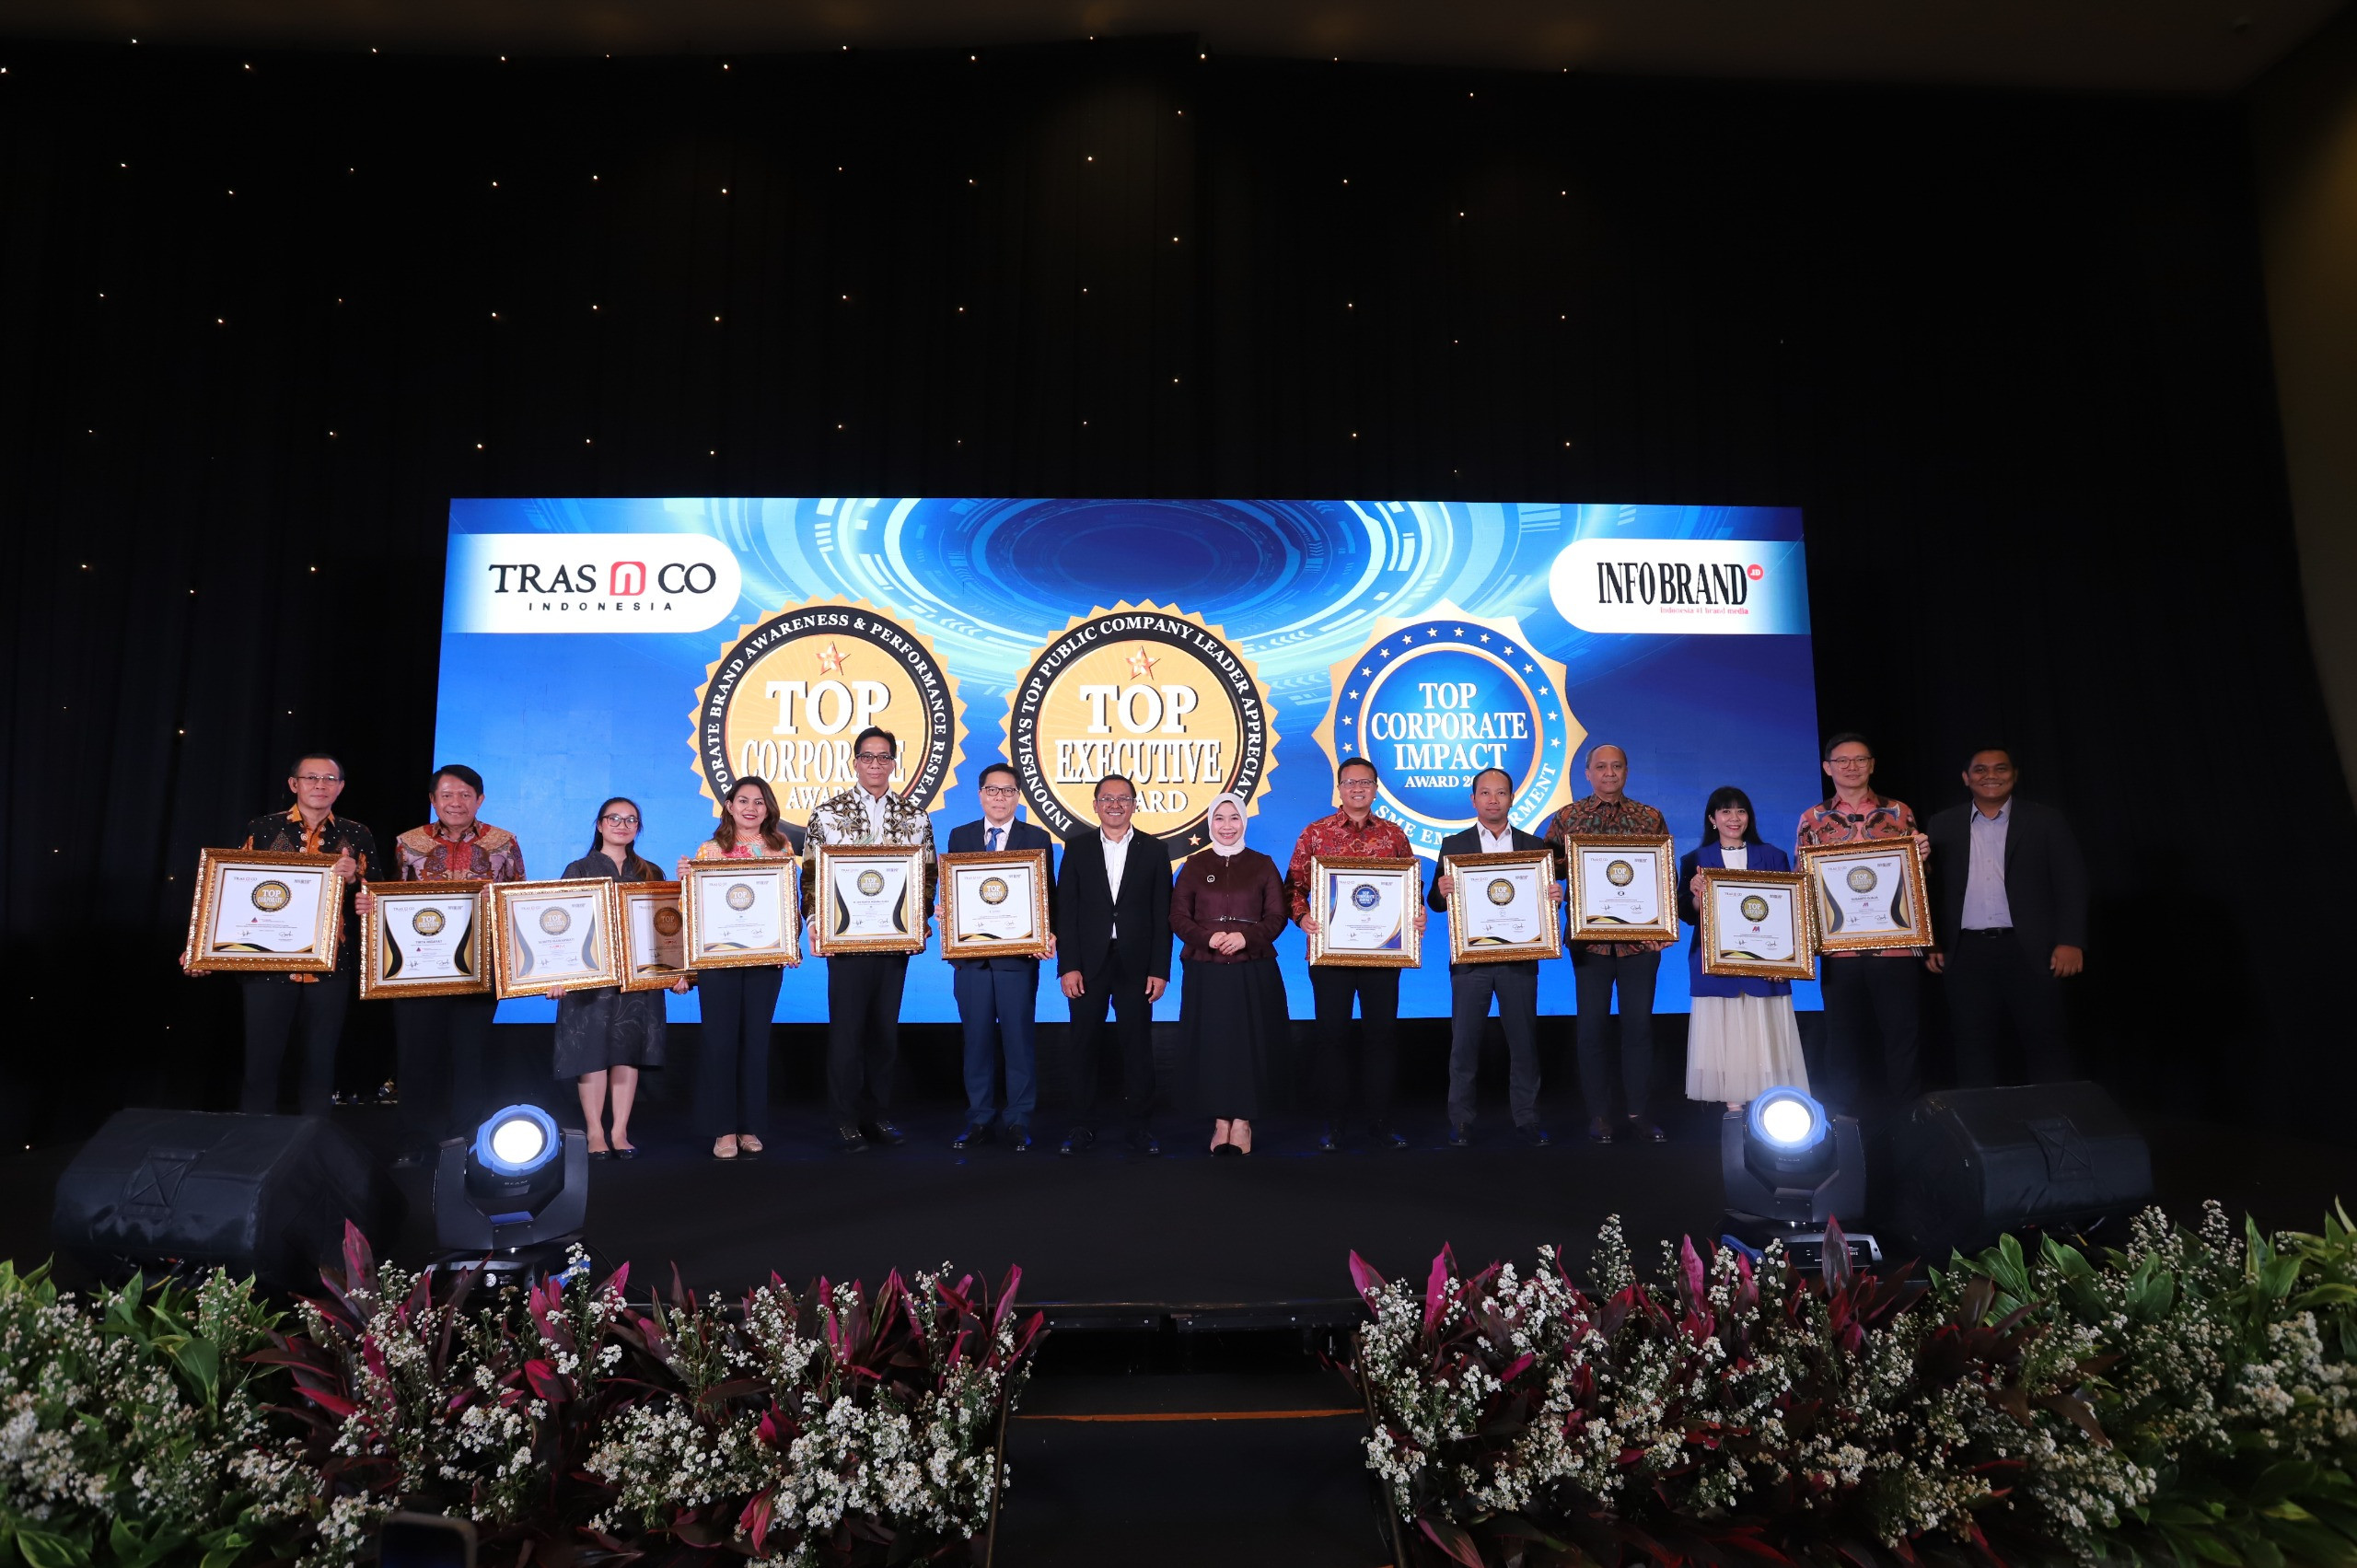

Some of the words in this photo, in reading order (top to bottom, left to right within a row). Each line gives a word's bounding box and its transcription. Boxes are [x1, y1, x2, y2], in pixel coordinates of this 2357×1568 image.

[489, 563, 597, 593] TRAS
[657, 563, 716, 594] CO
[528, 602, 672, 610] INDONESIA
[853, 617, 865, 631] &
[1099, 616, 1194, 640] COMPANY
[744, 613, 849, 660] AWARENESS
[1038, 627, 1097, 678] PUBLIC
[869, 622, 946, 735] PERFORMANCE
[1192, 632, 1249, 694] LEADER
[709, 658, 744, 718] BRAND
[765, 680, 891, 735] TOP
[1021, 677, 1039, 713] TOP
[1079, 684, 1199, 735] TOP
[1419, 682, 1477, 709] TOP
[1234, 697, 1261, 801] APPRECIAT
[1371, 712, 1527, 740] CORPORATE
[708, 723, 733, 794] PORATE
[740, 738, 905, 784] CORPORE
[908, 740, 946, 807] RESEAR
[1017, 717, 1074, 832] INDONESIA'S
[1055, 738, 1223, 784] EXECUTIVE
[1393, 743, 1507, 771] IMPACT
[1135, 790, 1189, 813] ARD
[1404, 775, 1460, 788] AWARD
[1375, 805, 1417, 838] SME
[262, 889, 282, 898] TOP
